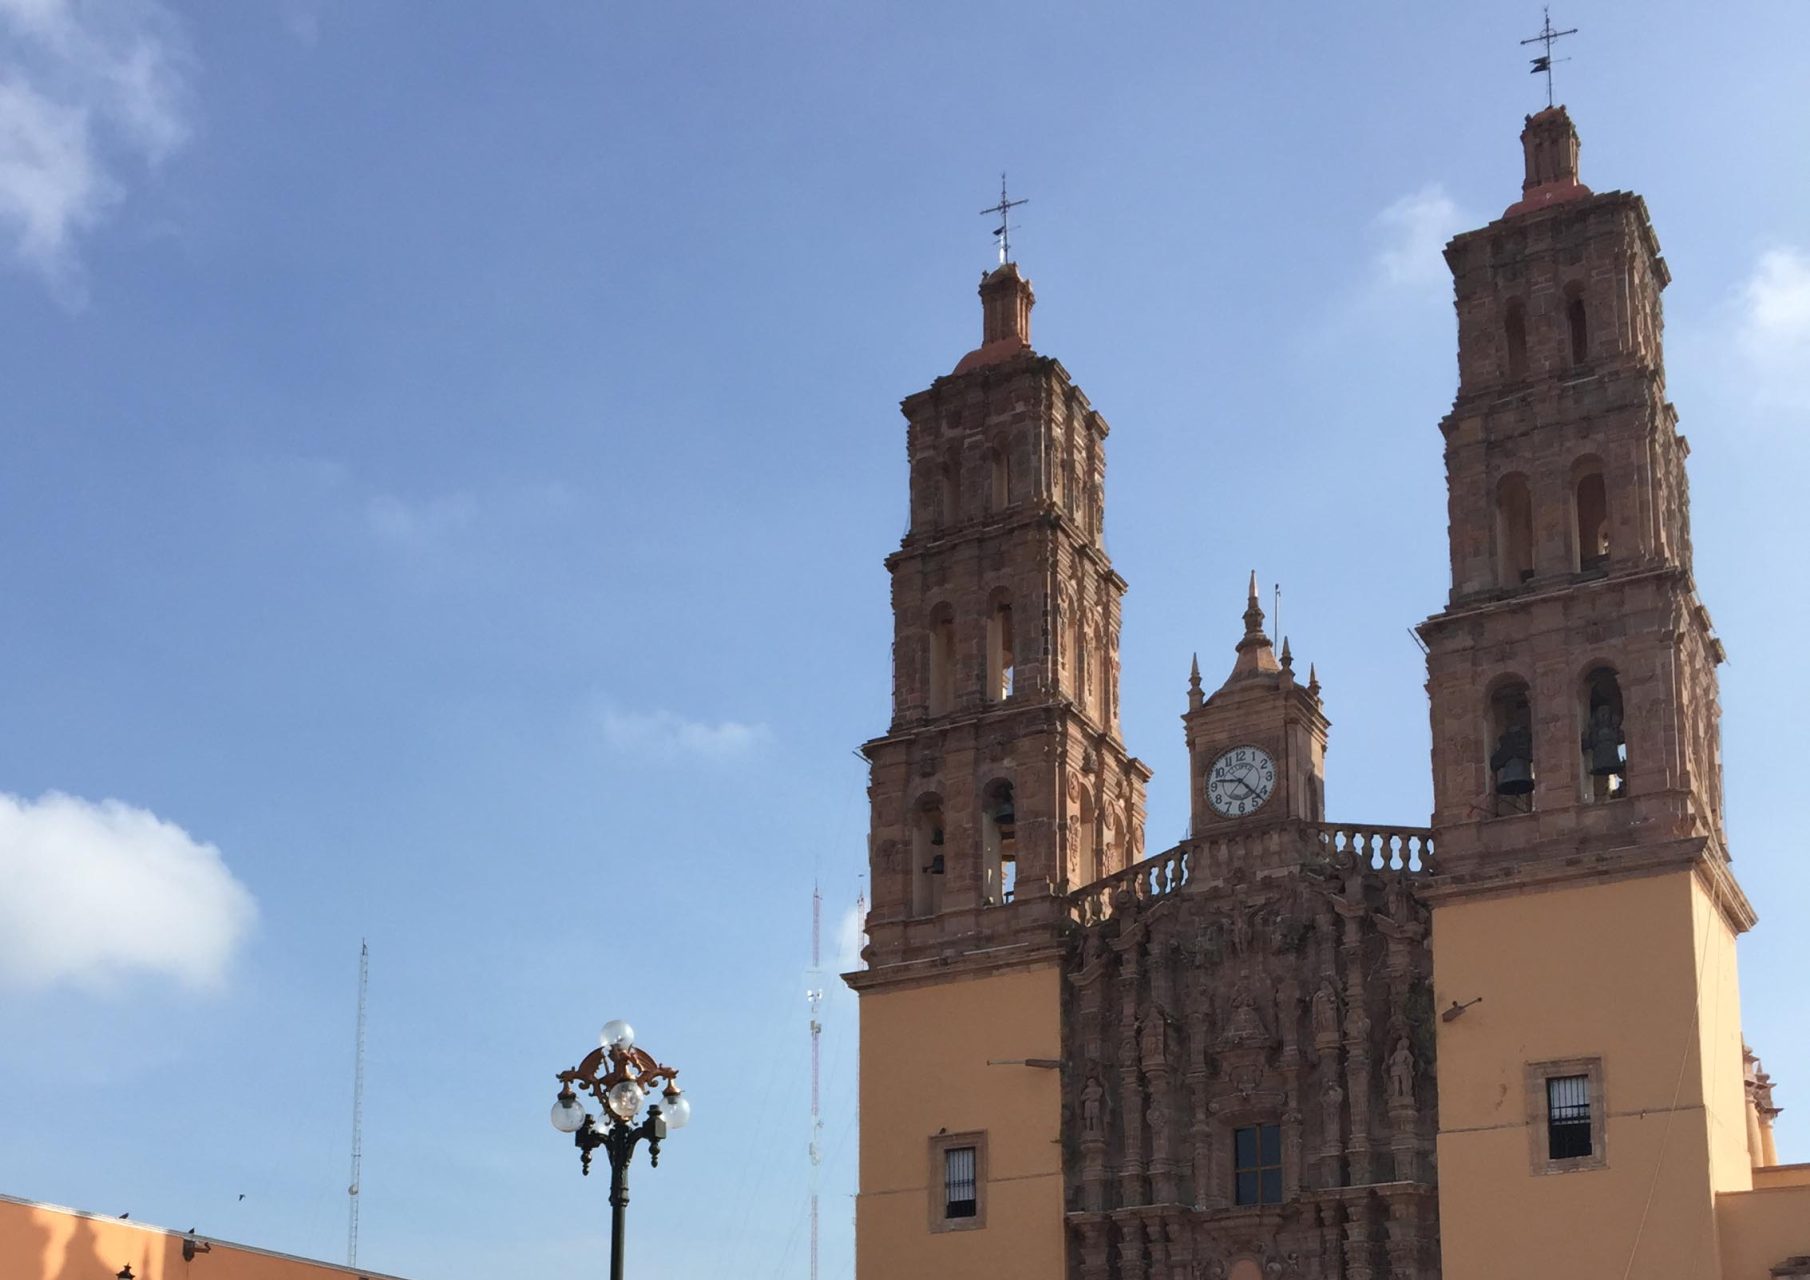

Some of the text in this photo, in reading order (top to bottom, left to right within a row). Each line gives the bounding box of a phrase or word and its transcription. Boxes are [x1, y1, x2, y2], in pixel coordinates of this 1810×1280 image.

[1225, 756, 1232, 767] 11
[1236, 751, 1246, 762] 12
[1260, 759, 1268, 769] 2
[1215, 767, 1224, 778] 10
[1265, 771, 1272, 782] 3
[1211, 782, 1217, 792] 9
[1260, 785, 1267, 795] 4
[1215, 794, 1222, 804] 8
[1252, 796, 1259, 807] 5
[1225, 802, 1232, 814] 7
[1238, 802, 1245, 812] 6
